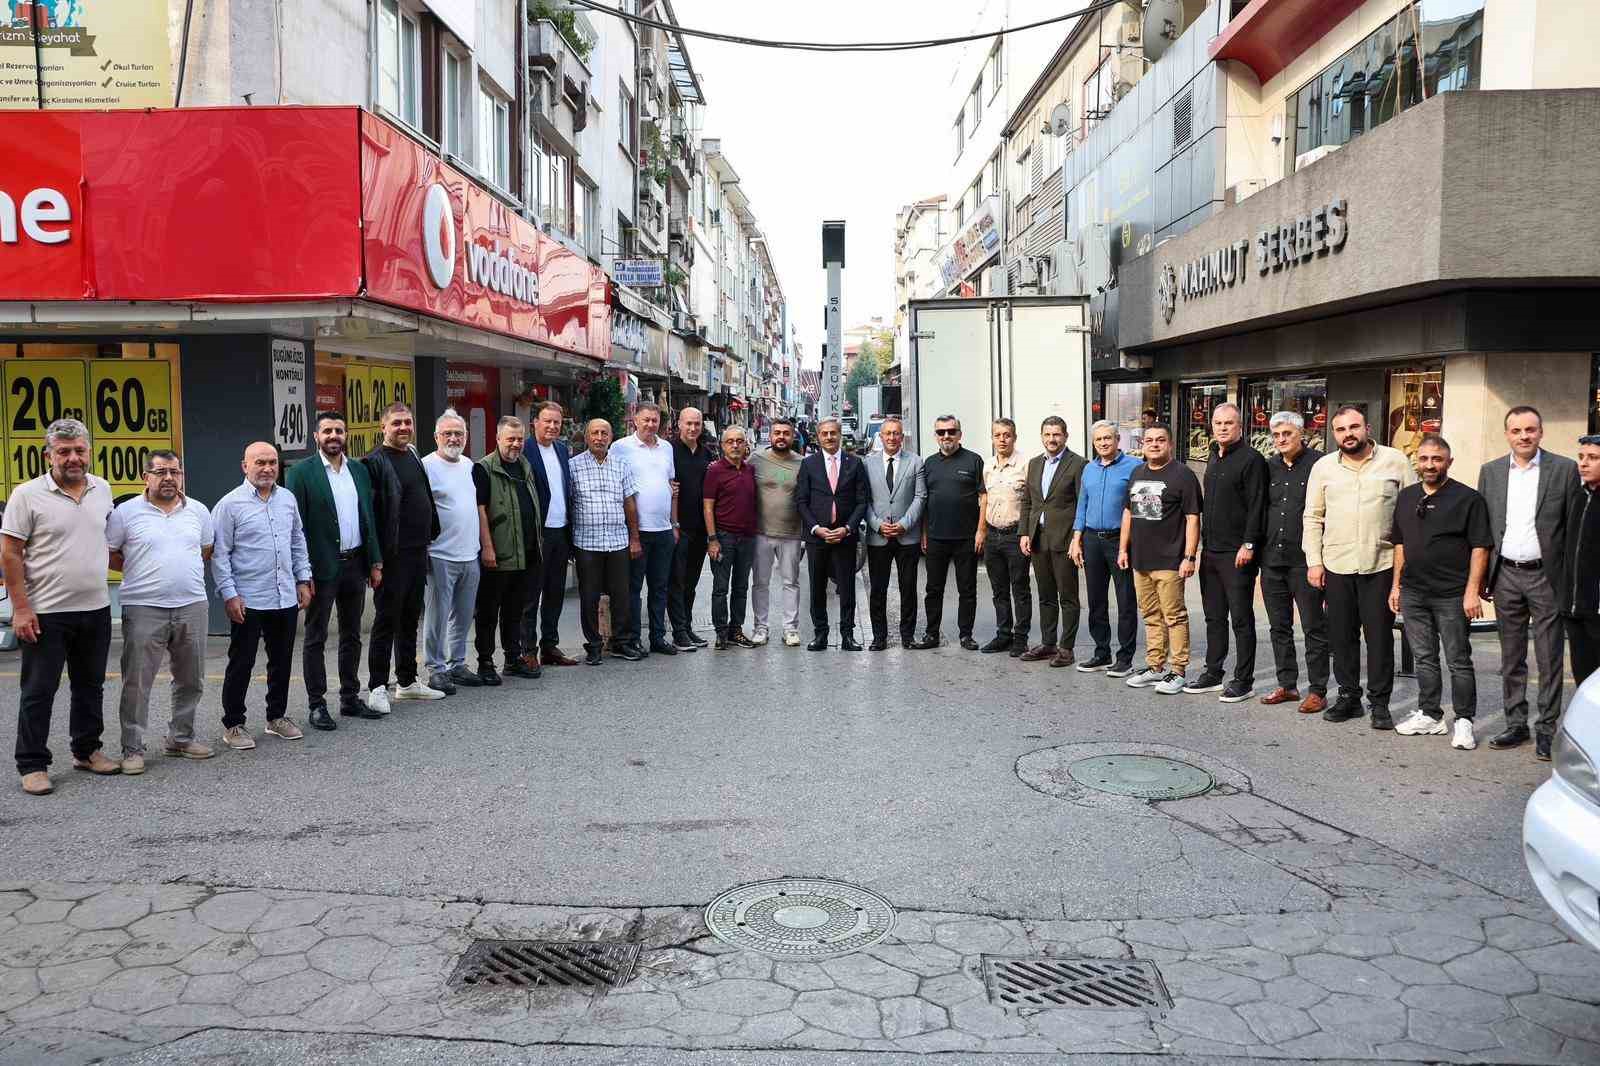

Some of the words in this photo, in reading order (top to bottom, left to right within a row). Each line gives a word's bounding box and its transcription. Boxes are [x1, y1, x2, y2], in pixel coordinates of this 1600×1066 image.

[466, 240, 539, 306] vodafone
[1180, 240, 1248, 296] MAHMUT
[279, 403, 304, 444] 490
